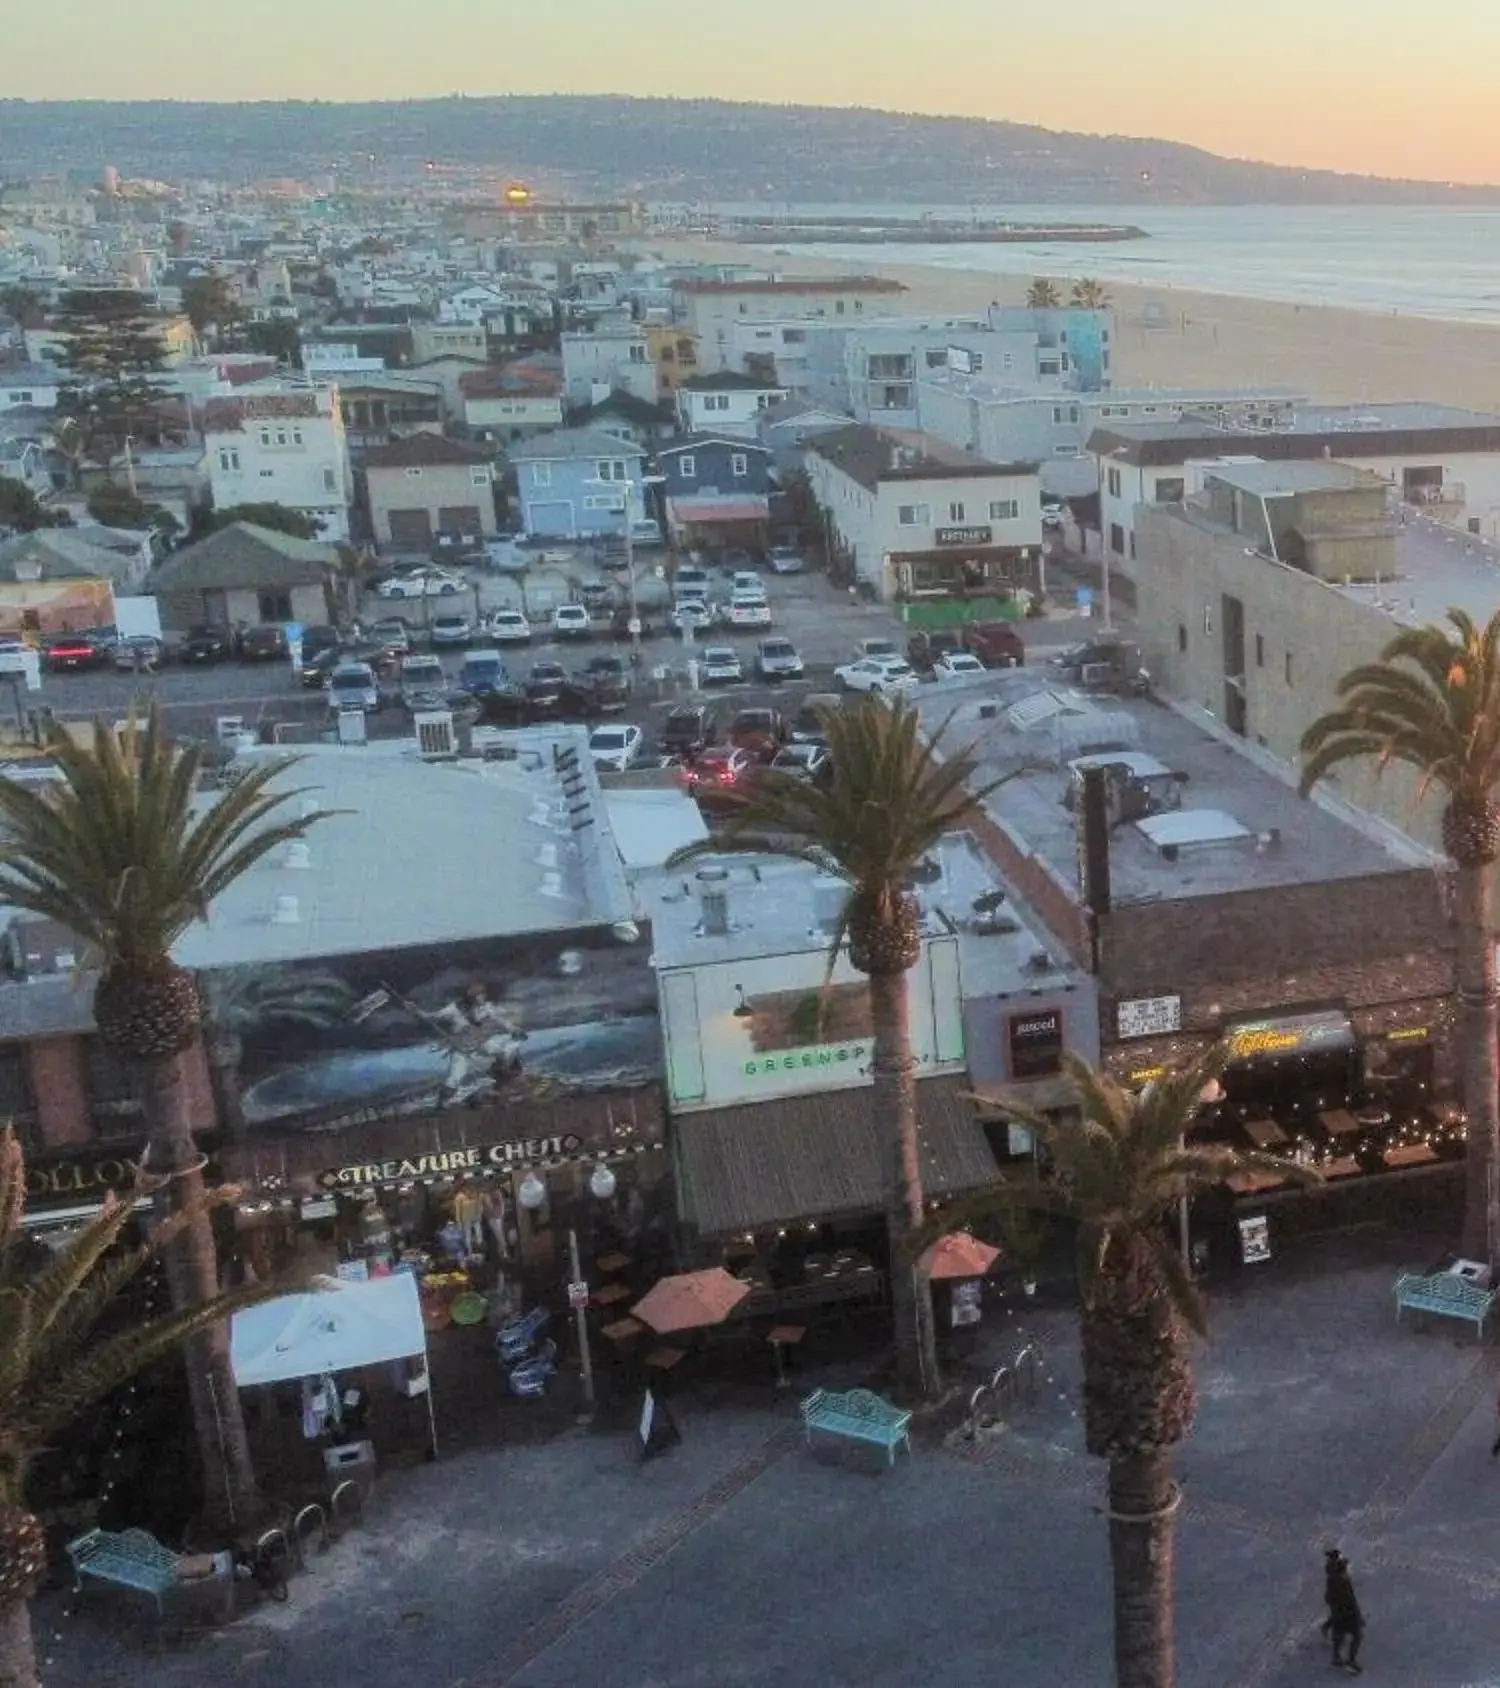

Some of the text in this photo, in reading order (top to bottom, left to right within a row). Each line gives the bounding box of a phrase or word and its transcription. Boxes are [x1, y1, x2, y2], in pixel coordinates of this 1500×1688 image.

[744, 1046, 866, 1076] GREENSP
[337, 1135, 564, 1185] TREASURE CHEST
